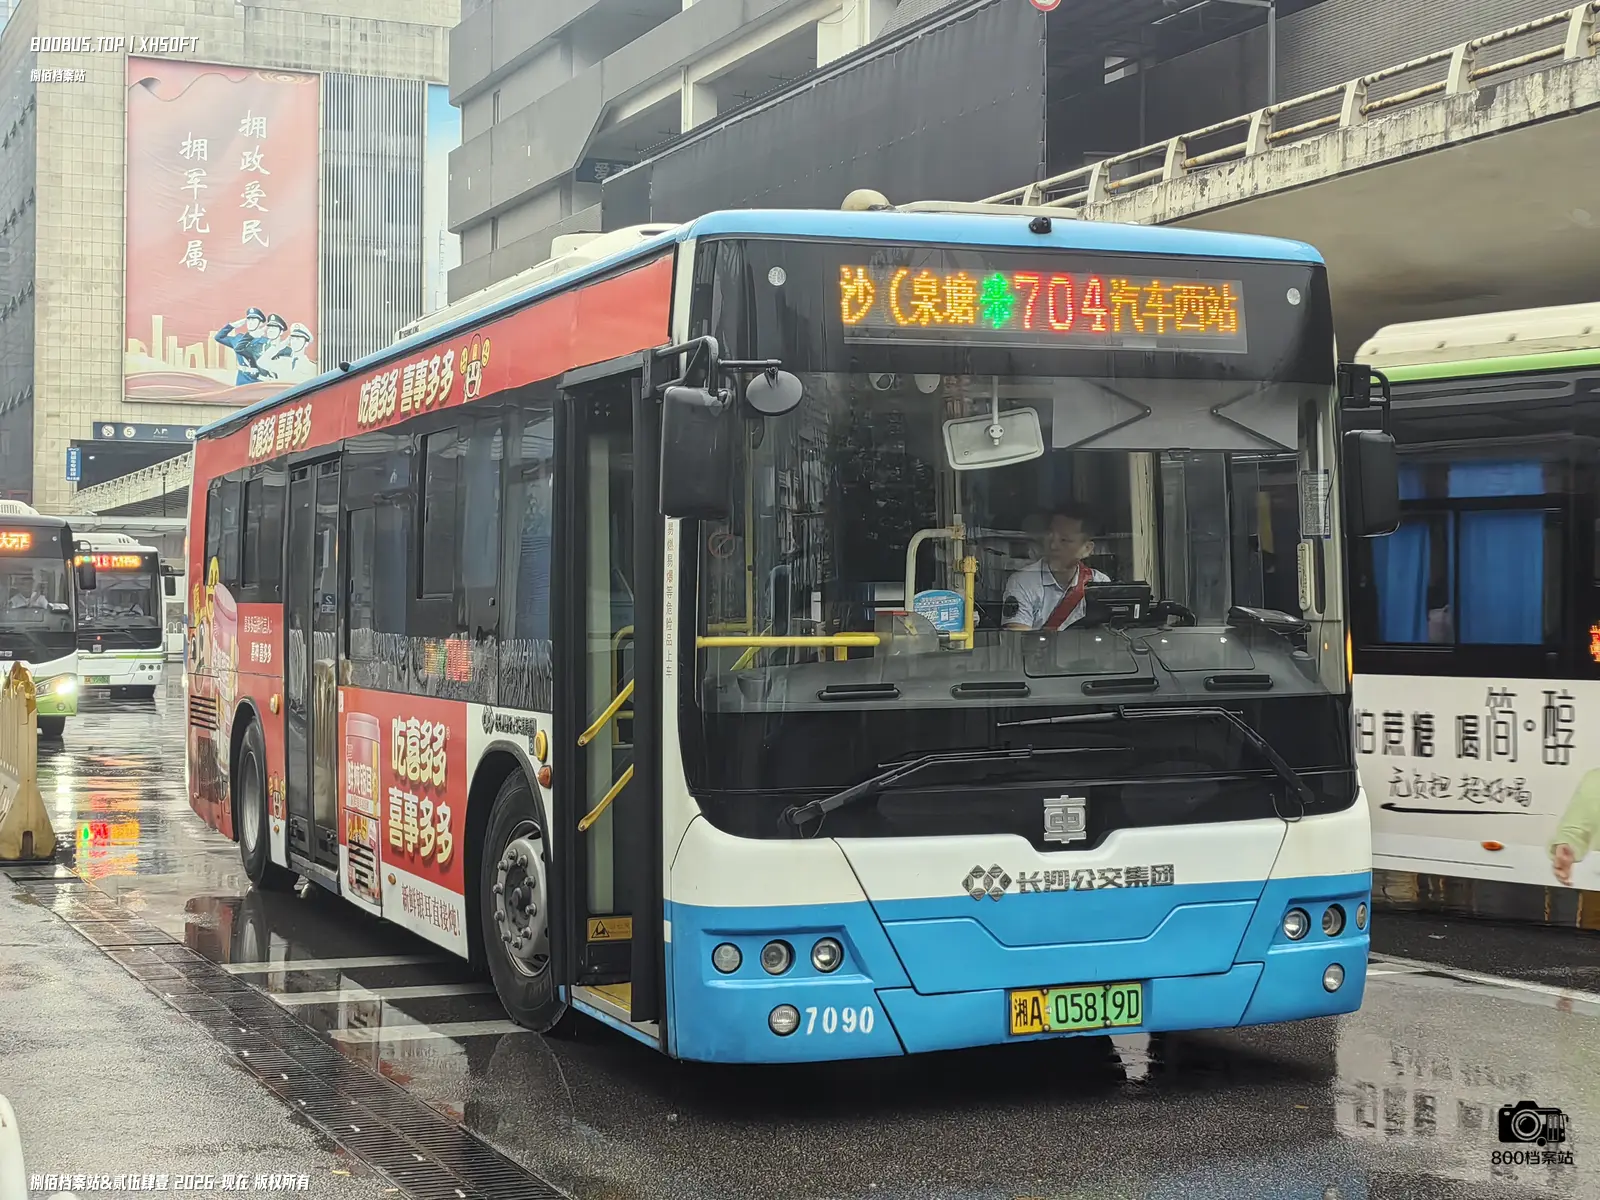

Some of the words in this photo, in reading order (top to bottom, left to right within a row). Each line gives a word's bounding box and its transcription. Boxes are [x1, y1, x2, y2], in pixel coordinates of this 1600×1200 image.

[177, 131, 210, 272] 拥军优属
[238, 109, 271, 248] 拥政爱民
[1014, 271, 1108, 332] 704
[1109, 278, 1238, 335] 汽车西站
[388, 786, 453, 864] 喜事多多
[805, 1005, 875, 1035] 7090
